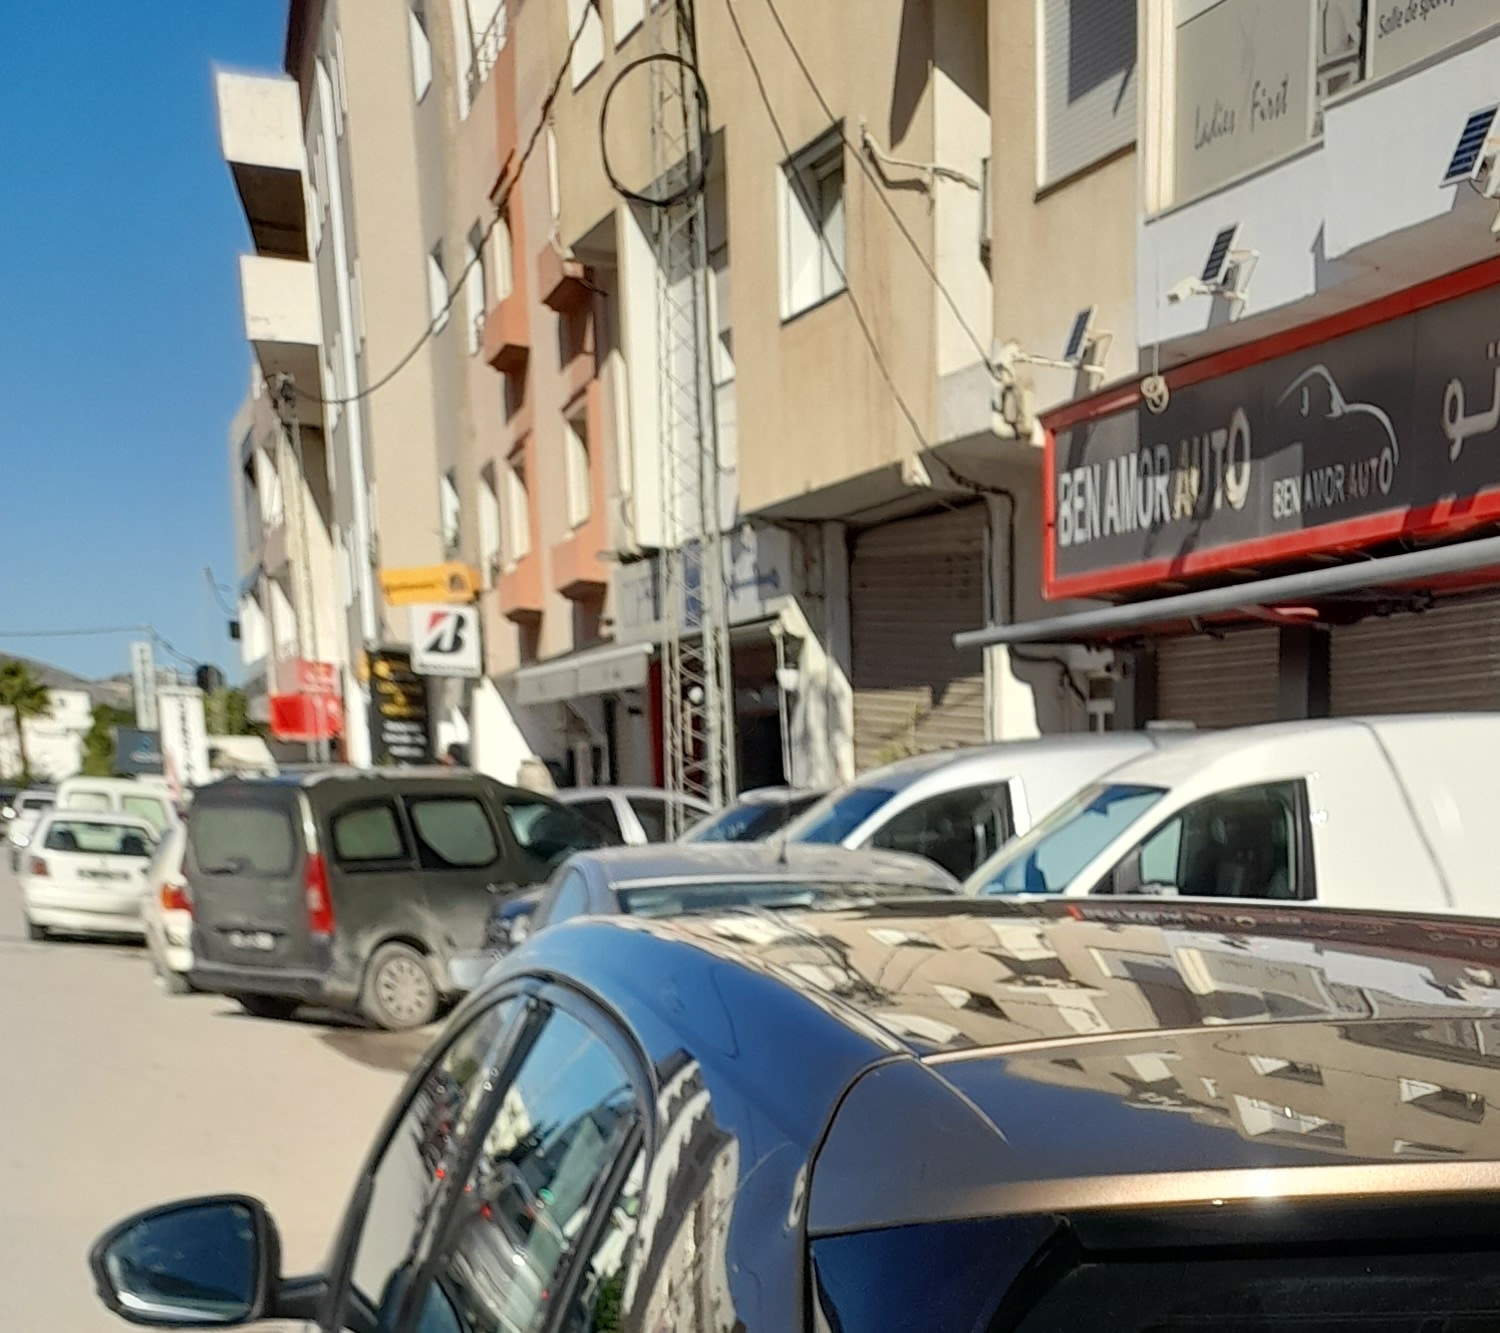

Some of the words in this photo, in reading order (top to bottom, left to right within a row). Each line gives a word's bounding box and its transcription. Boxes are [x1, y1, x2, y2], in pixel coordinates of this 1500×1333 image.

[1058, 463, 1101, 548] BEN
[1102, 443, 1171, 536] AMOR
[1172, 406, 1251, 521] AUTO
[1273, 475, 1302, 520] BEN
[1303, 463, 1346, 513] AMOR
[1346, 446, 1394, 500] AUTO
